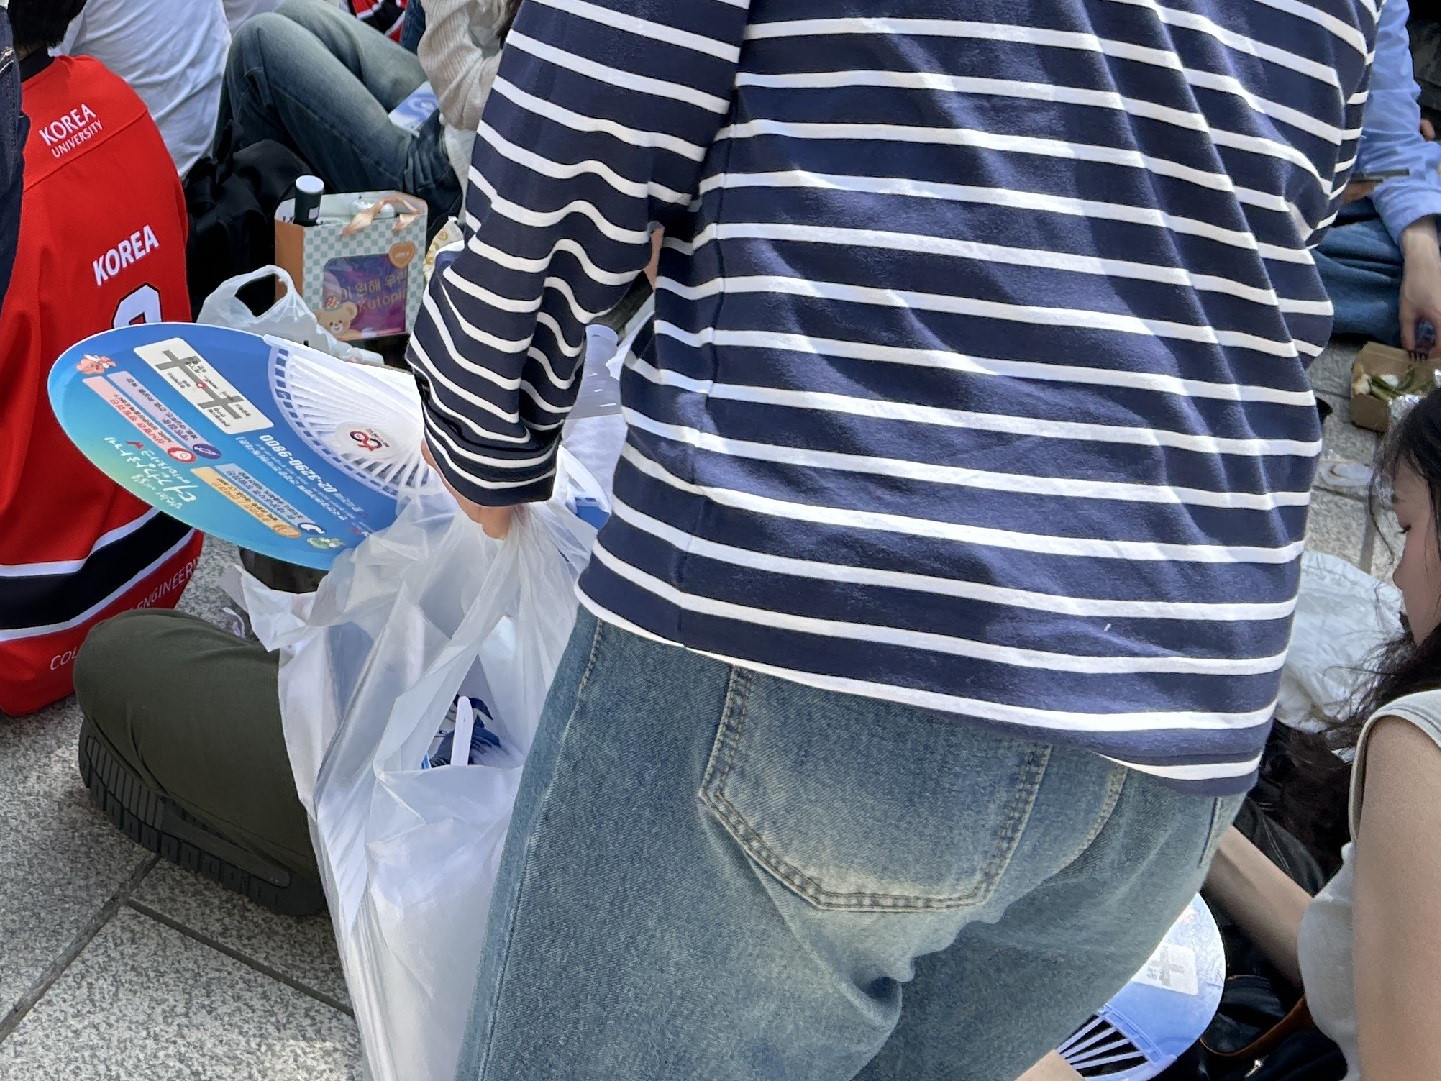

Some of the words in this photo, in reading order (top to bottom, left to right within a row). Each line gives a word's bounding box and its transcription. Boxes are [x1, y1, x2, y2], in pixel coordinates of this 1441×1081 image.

[39, 103, 97, 146] KOREA
[51, 119, 103, 159] UNIVERSITY
[92, 224, 160, 286] KOREA
[257, 432, 340, 493] 02-3290-9800
